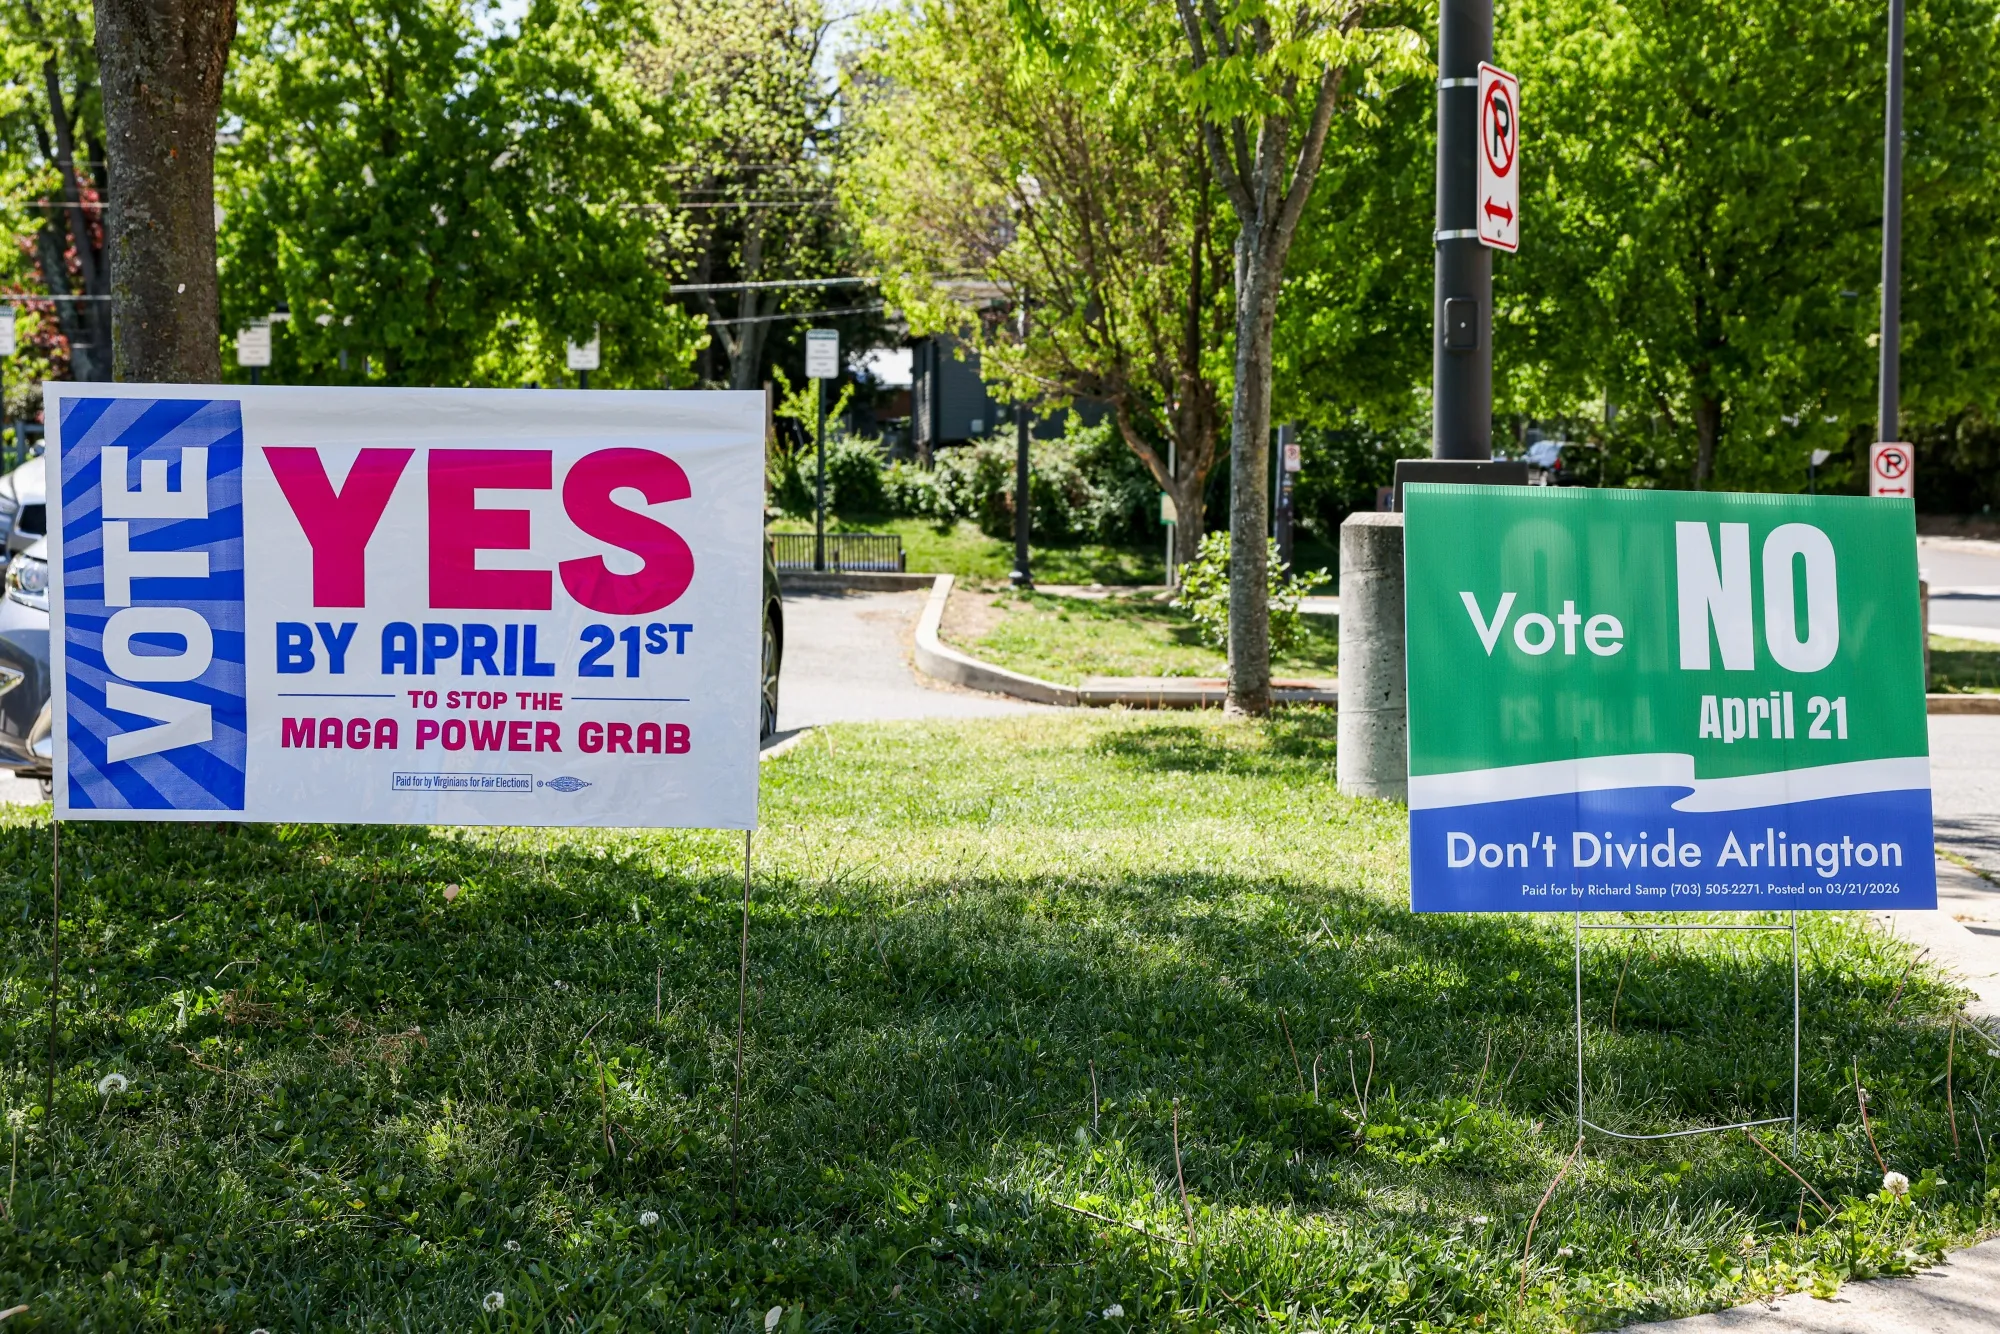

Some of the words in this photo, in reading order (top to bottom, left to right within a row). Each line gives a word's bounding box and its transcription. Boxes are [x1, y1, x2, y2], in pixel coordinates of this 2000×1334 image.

[262, 447, 695, 615] YES
[102, 446, 214, 764] VOTE
[1459, 591, 1624, 657] Vote
[1675, 520, 1839, 673] NO
[276, 622, 357, 674] BY
[381, 622, 555, 677] APRIL
[579, 622, 694, 678] 21ST
[407, 690, 438, 709] TO
[446, 690, 508, 710] STOP
[516, 692, 563, 711] THE
[1699, 691, 1794, 743] April
[1808, 696, 1848, 740] 21
[281, 717, 399, 750] MAGA
[415, 719, 562, 753] POWER
[578, 722, 691, 755] GRAB
[395, 775, 411, 787] Paid
[413, 776, 423, 787] for
[424, 776, 433, 789] by
[434, 776, 468, 789] Virginians
[469, 776, 480, 788] for
[481, 776, 495, 788] Fair
[496, 777, 530, 789] Elections
[1446, 831, 1557, 869] Don't
[1572, 828, 1702, 870] Divide
[1716, 828, 1903, 878] Arlington
[1522, 884, 1547, 896] Paid
[1551, 883, 1567, 896] for
[1571, 883, 1584, 898] by
[1588, 883, 1631, 896] Richard
[1635, 884, 1667, 898] Samp
[1671, 883, 1701, 898] (703)
[1705, 883, 1764, 895] 505-2271.
[1767, 883, 1805, 895] Posted
[1808, 886, 1822, 895] on
[1826, 883, 1900, 895] 03/21/2026
